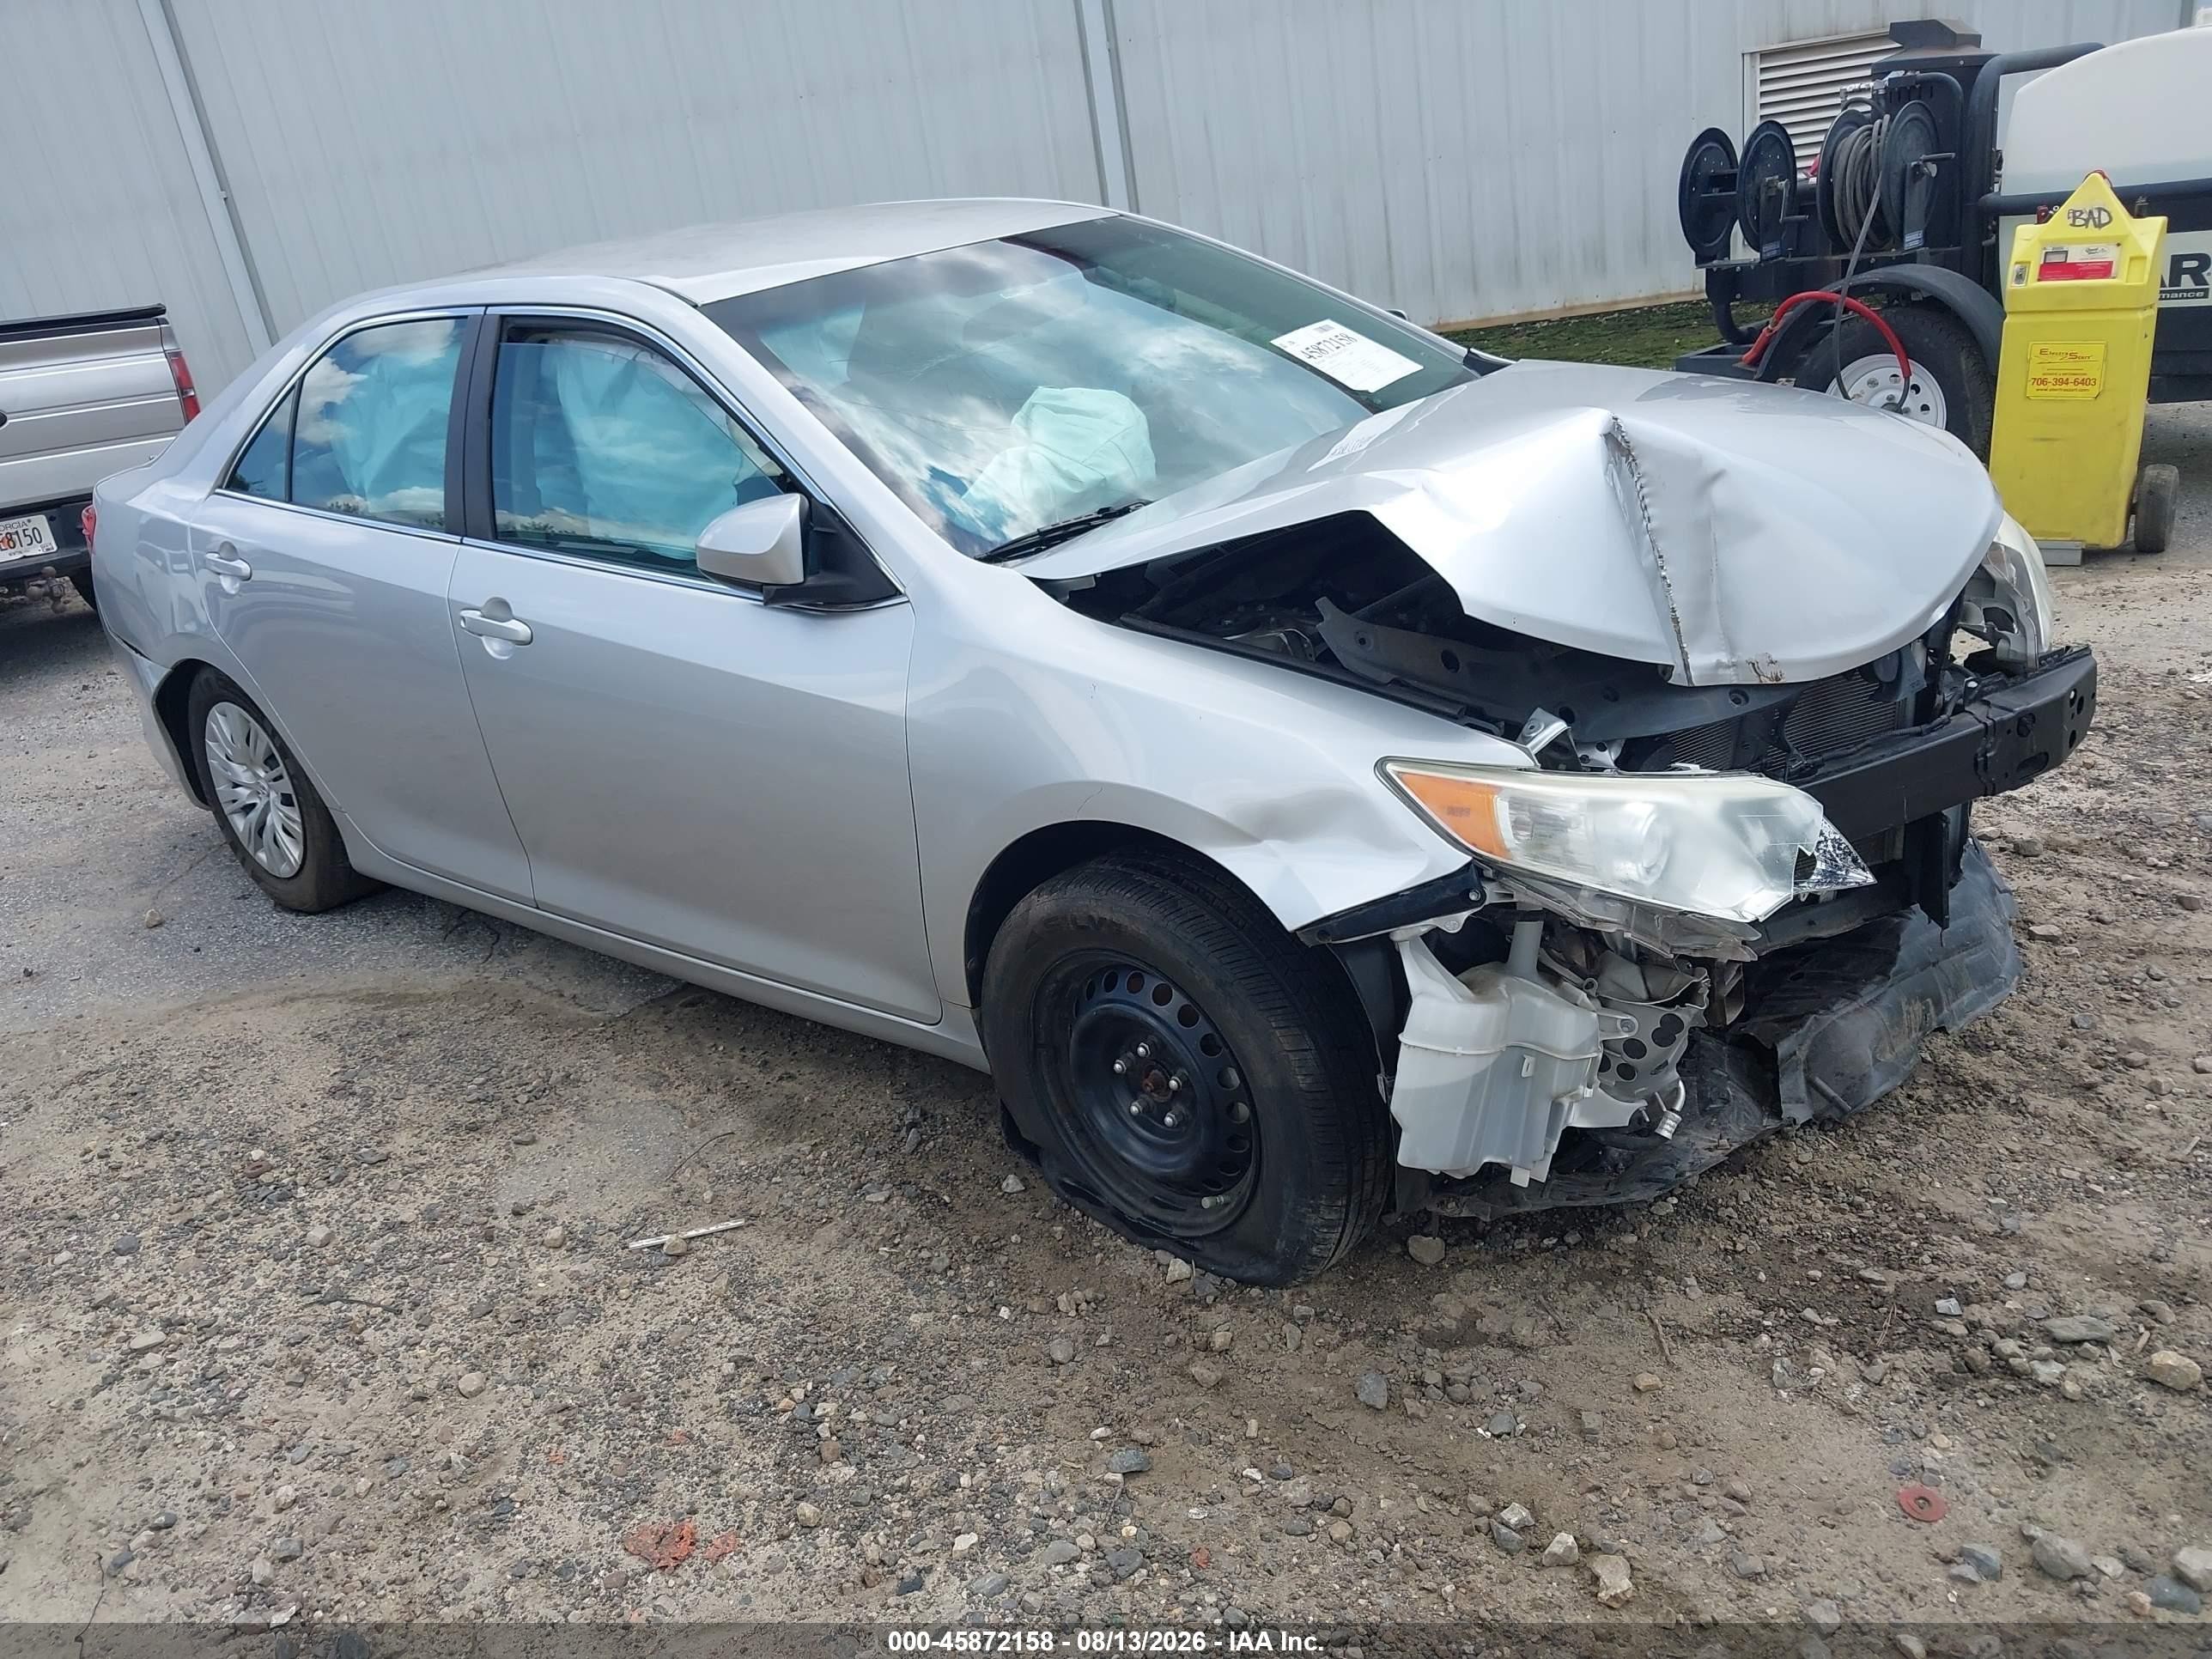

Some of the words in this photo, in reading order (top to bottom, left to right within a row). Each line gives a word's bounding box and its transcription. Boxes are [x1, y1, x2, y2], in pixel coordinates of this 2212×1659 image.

[2068, 206, 2113, 228] BAD
[2160, 252, 2211, 289] R
[1300, 332, 1358, 359] 45872158
[2031, 378, 2097, 386] 706-394-6403
